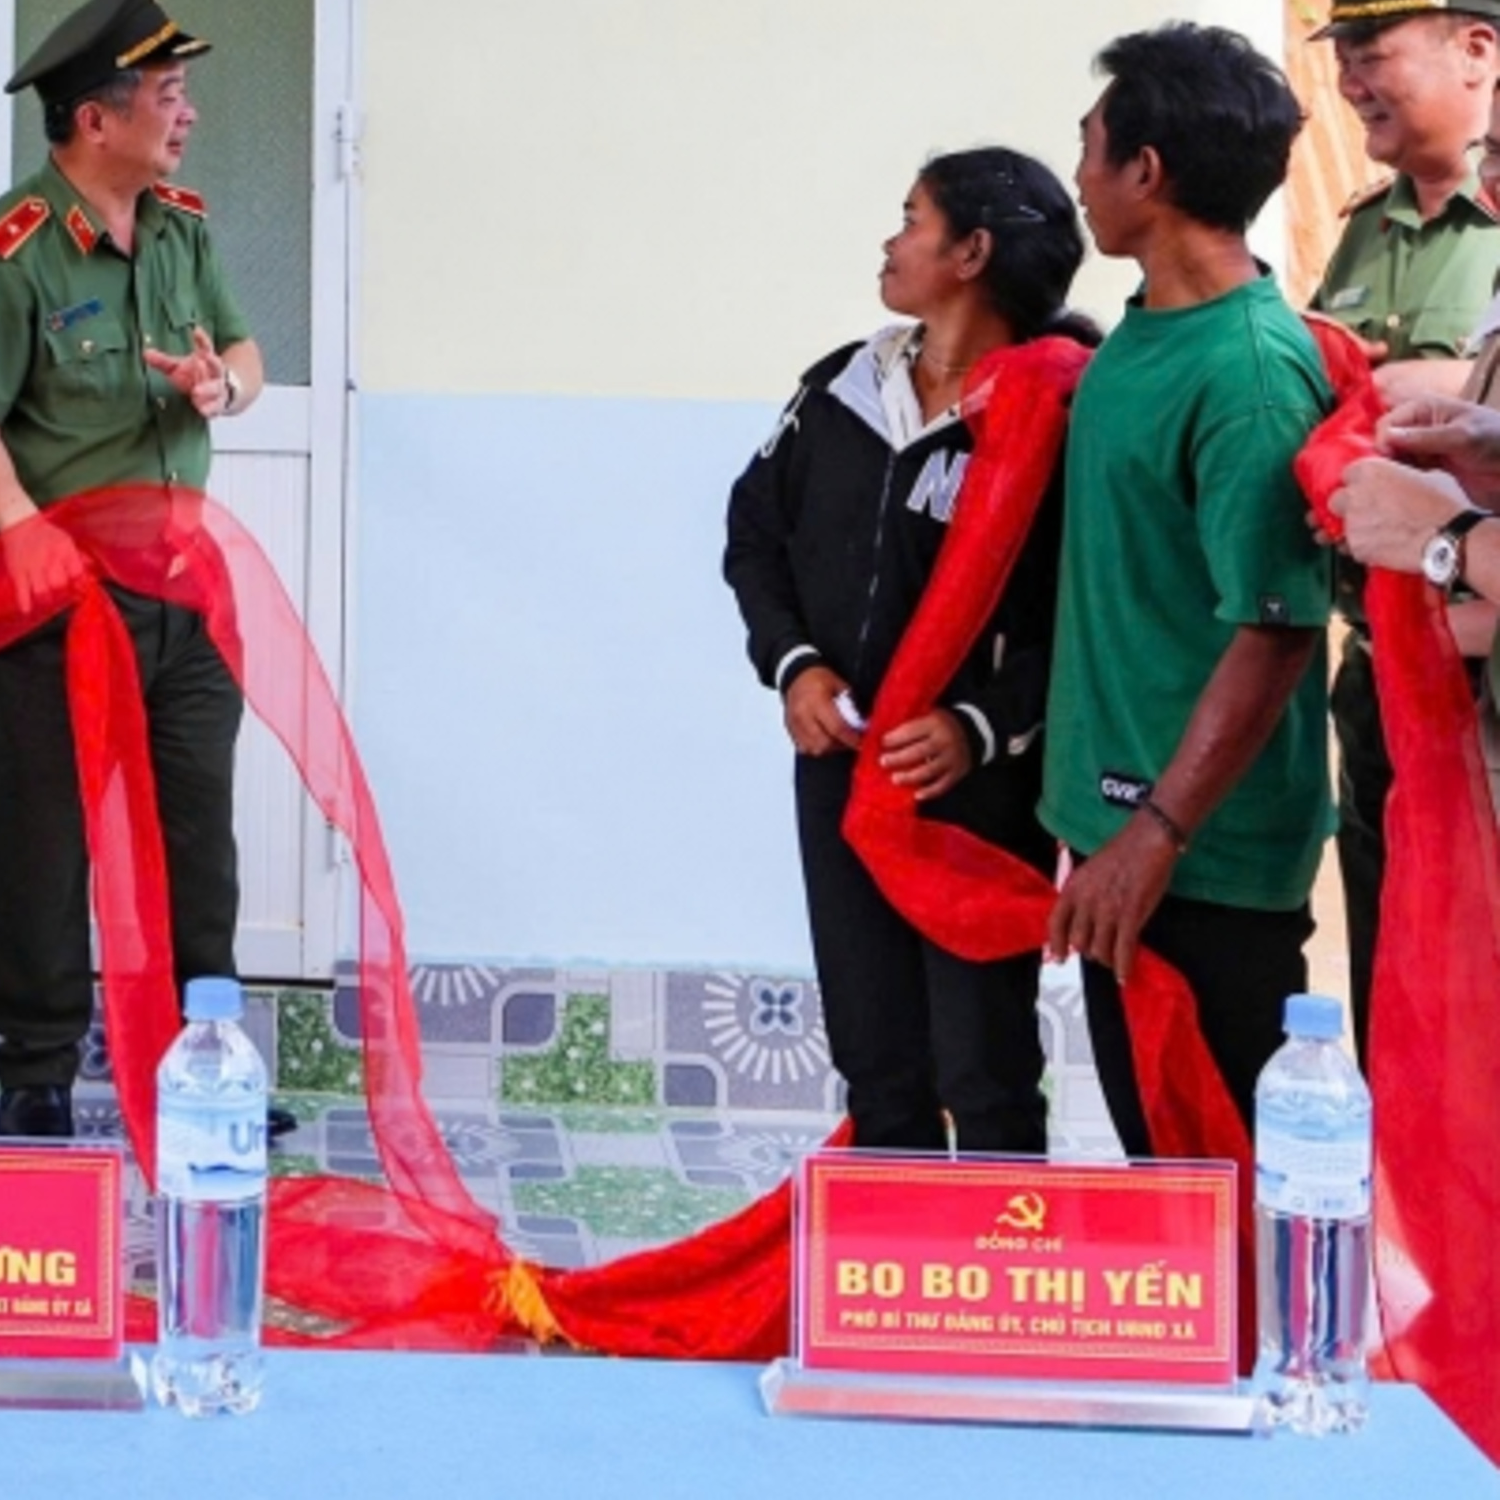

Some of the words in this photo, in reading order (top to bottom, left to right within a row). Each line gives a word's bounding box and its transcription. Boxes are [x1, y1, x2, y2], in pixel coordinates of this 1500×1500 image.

[836, 1259, 905, 1299] BO
[920, 1262, 991, 1302] BO
[1004, 1265, 1086, 1313] THỊ
[1102, 1258, 1203, 1310] YẾN
[838, 1308, 878, 1329] PHÓ
[881, 1309, 901, 1329] BÍ
[904, 1311, 942, 1330] THƯ
[1116, 1319, 1168, 1340] UBND
